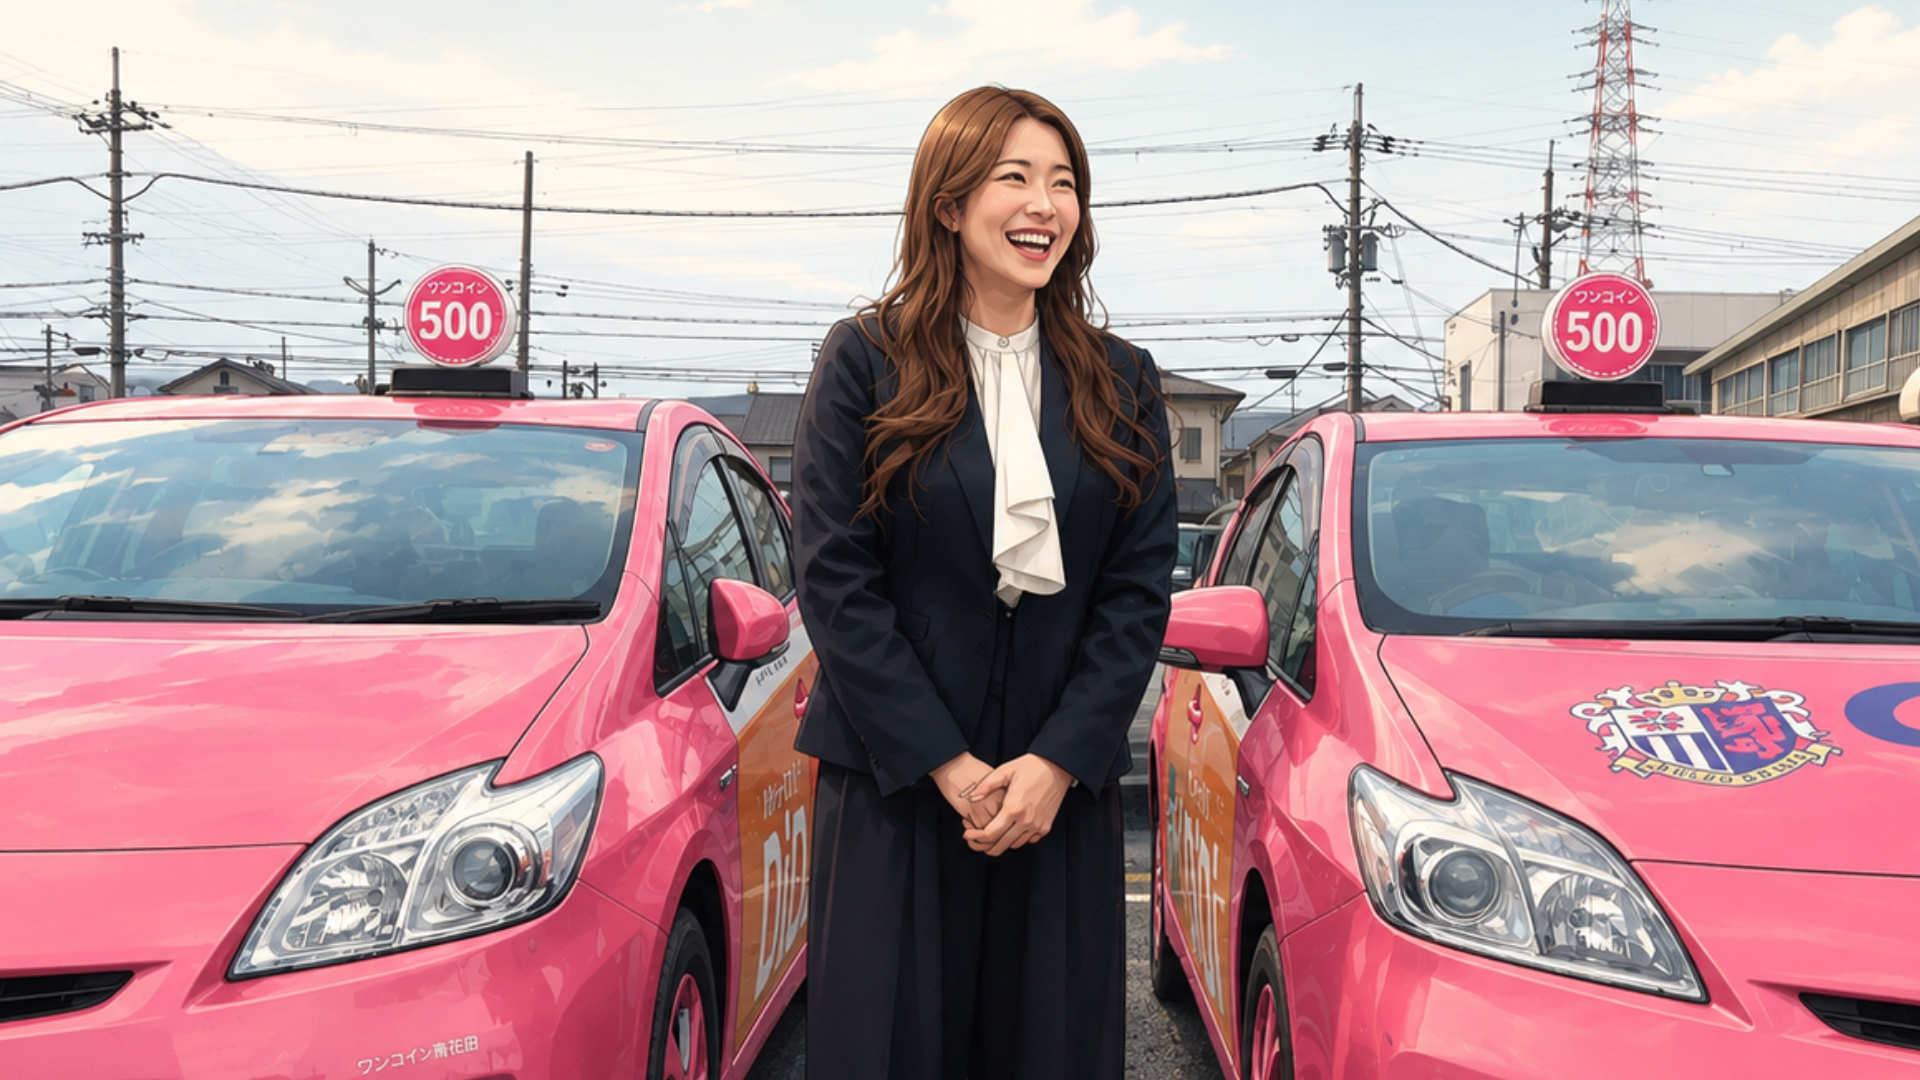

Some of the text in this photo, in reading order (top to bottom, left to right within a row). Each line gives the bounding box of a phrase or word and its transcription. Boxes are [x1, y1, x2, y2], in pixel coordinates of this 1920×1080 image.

[427, 281, 489, 295] ワンコイン
[1575, 289, 1640, 304] ワンコイン
[419, 300, 492, 341] 500
[1566, 310, 1643, 354] 500
